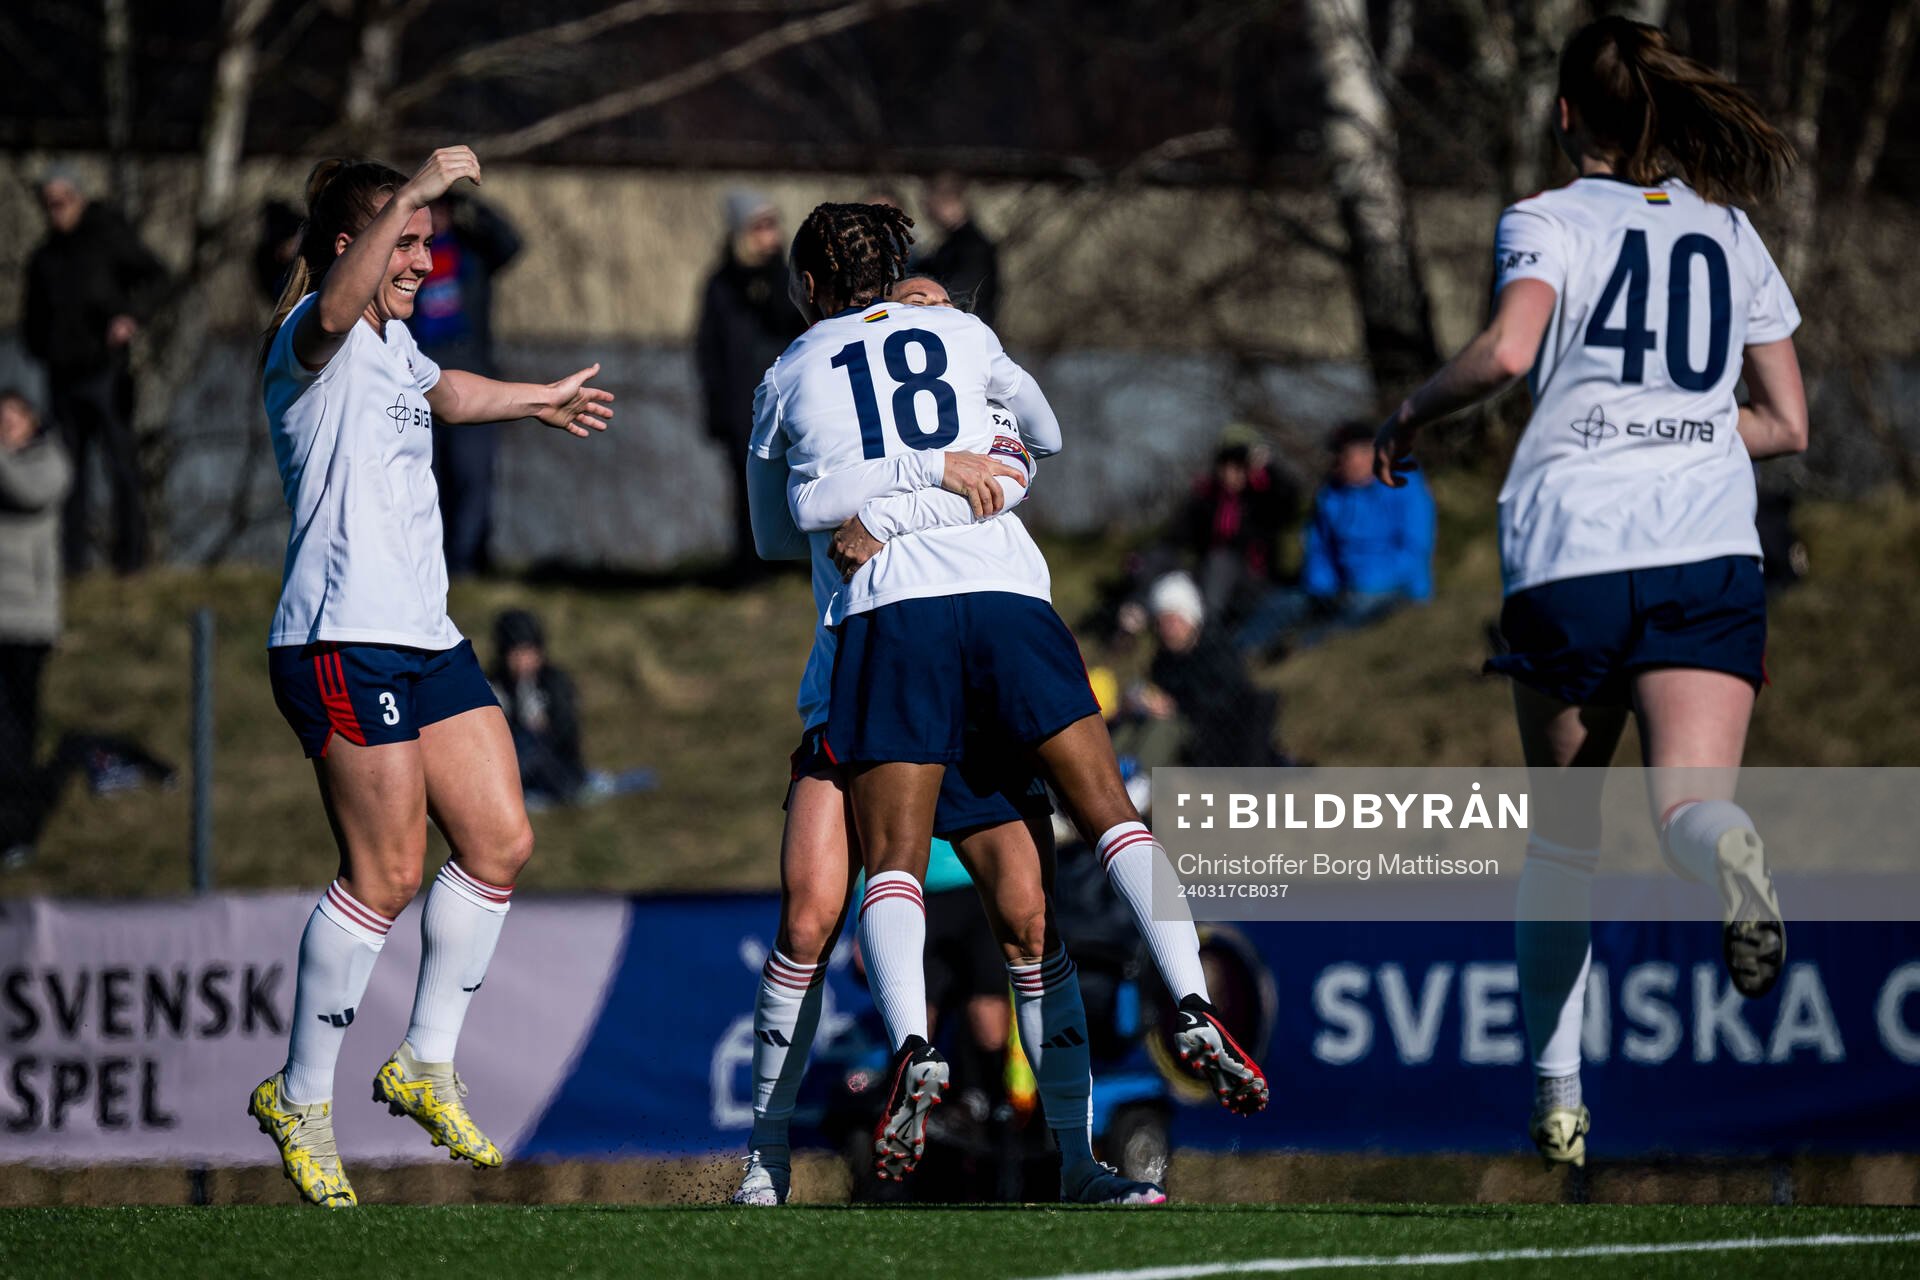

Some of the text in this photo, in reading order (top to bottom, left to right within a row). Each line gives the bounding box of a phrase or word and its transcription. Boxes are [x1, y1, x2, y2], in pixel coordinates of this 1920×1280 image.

[1584, 229, 1733, 393] 40
[413, 407, 431, 428] SIG
[830, 328, 960, 460] 18
[991, 413, 1017, 433] SA
[379, 691, 400, 725] 3
[5, 962, 290, 1039] SVENSK
[4, 1054, 180, 1131] SPEL
